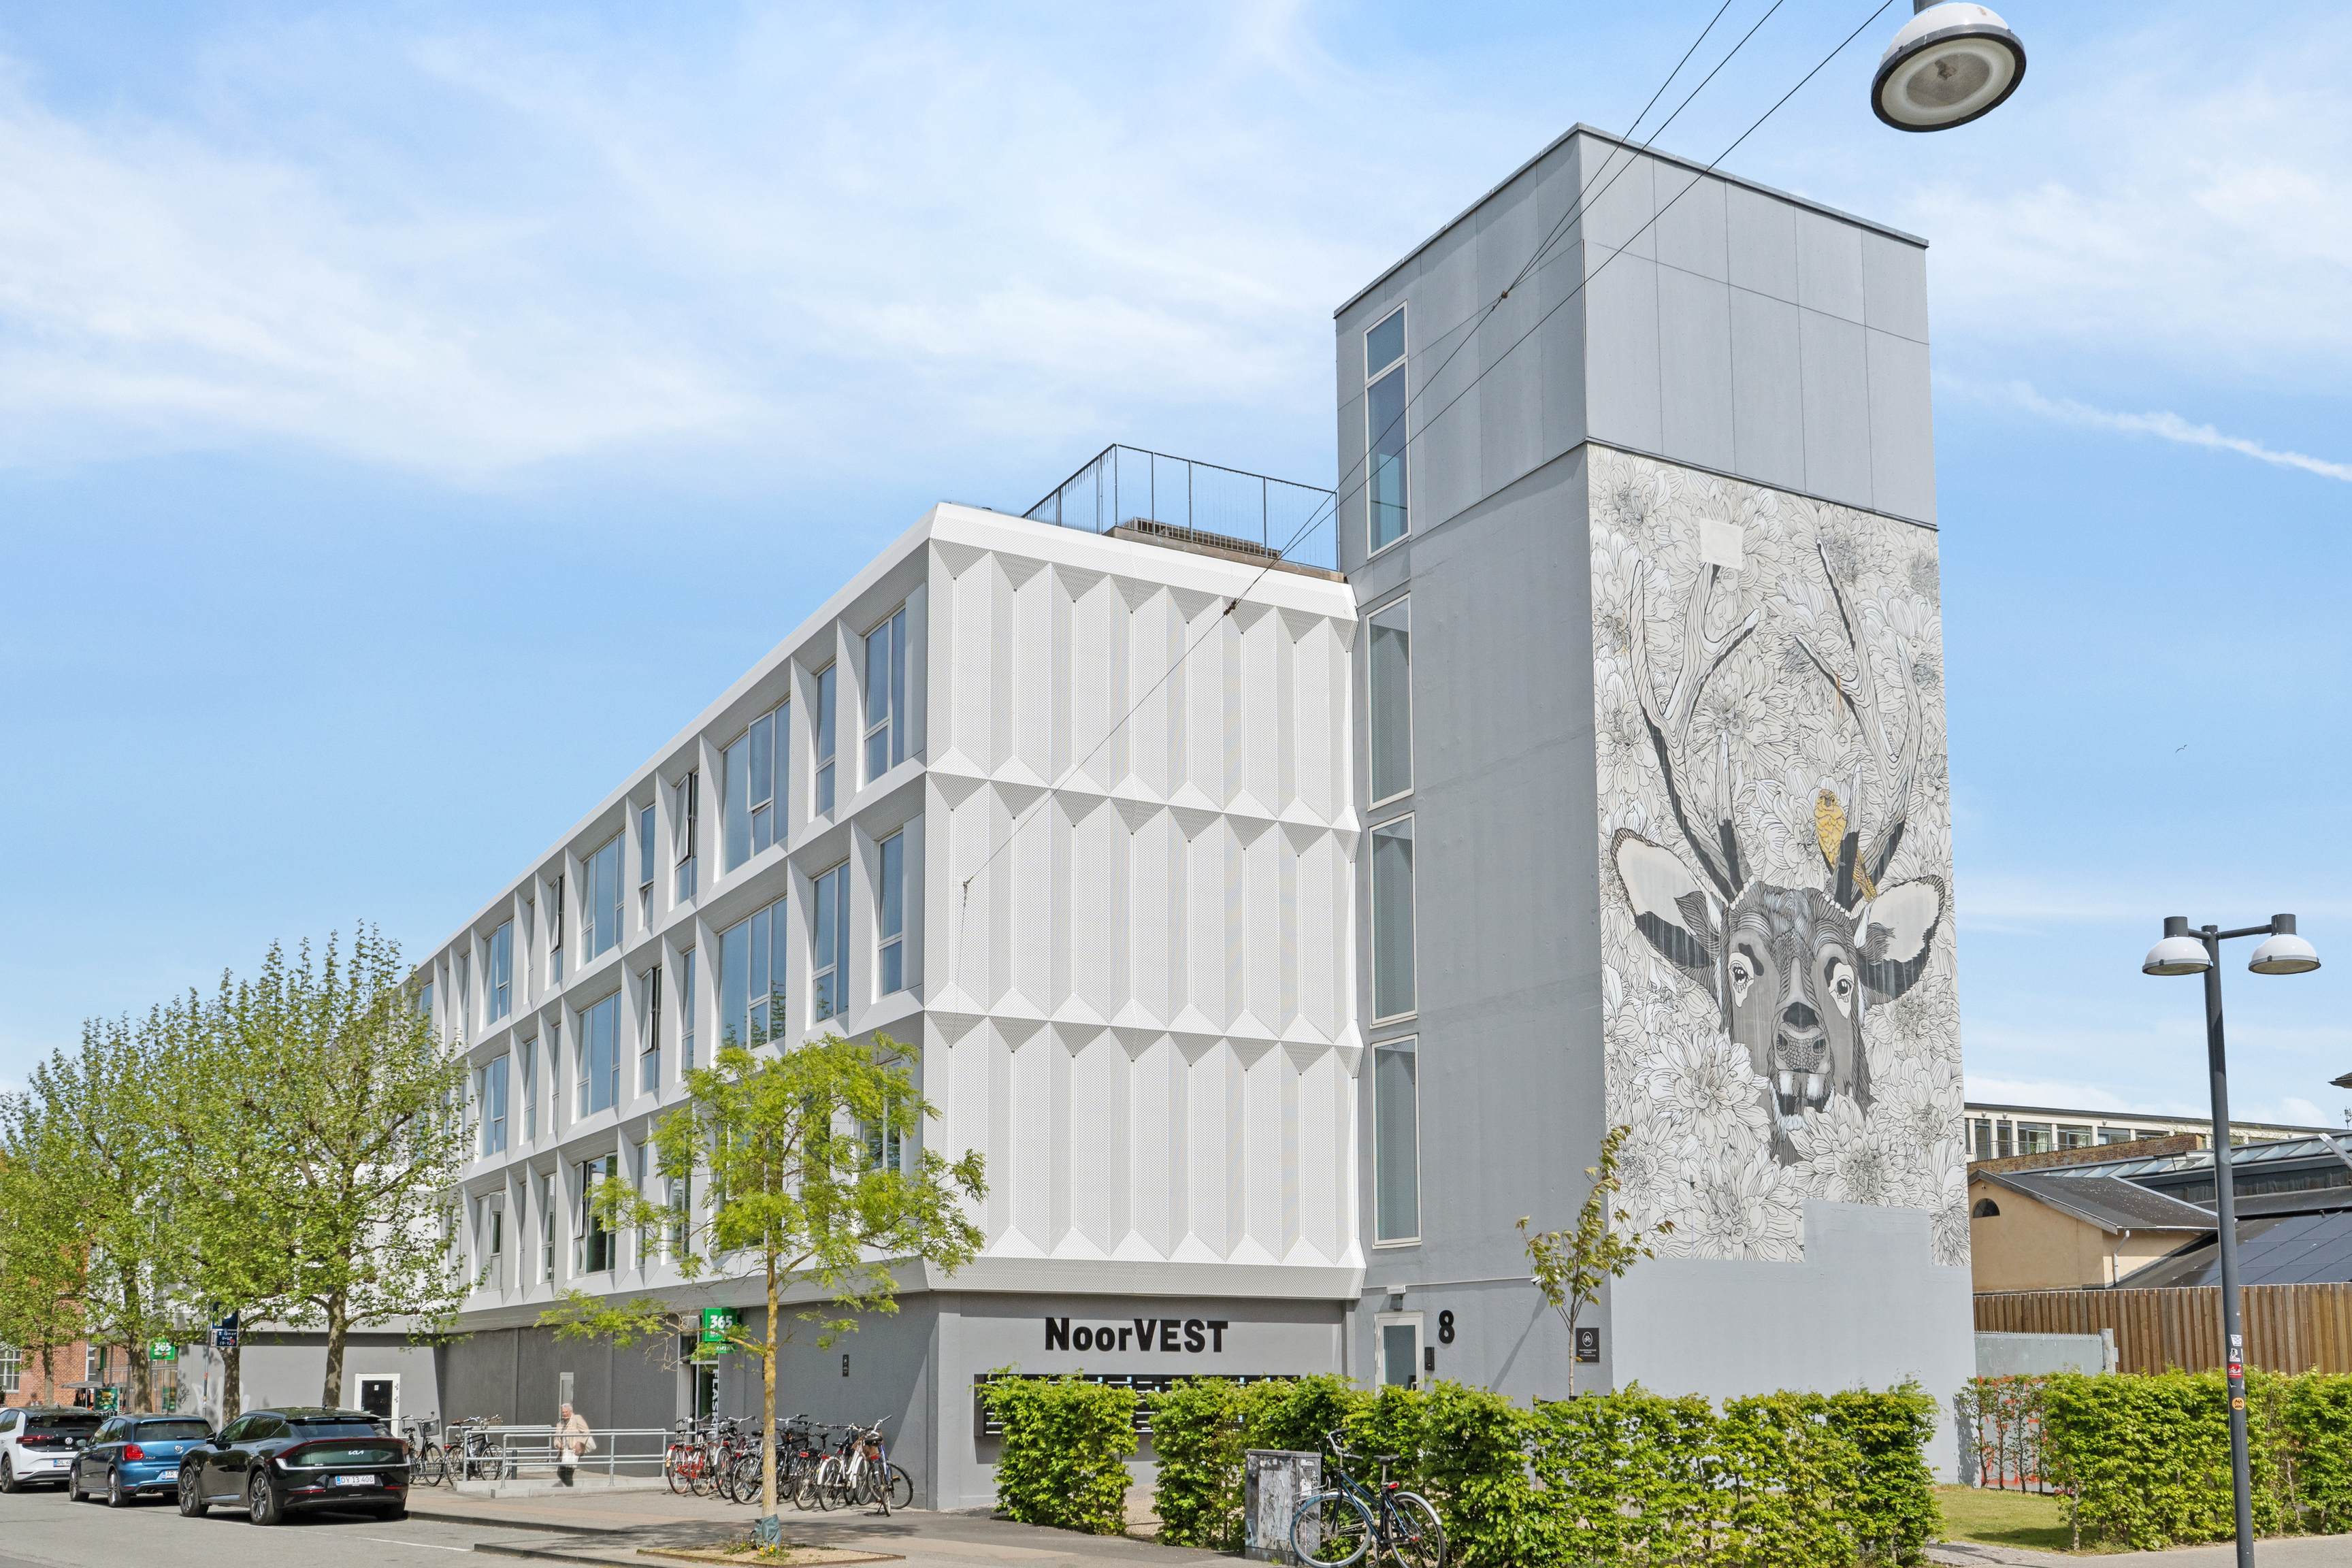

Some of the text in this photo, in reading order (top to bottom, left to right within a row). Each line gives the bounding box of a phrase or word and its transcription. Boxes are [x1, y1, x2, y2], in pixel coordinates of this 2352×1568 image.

[710, 1315, 733, 1329] 365
[1045, 1317, 1228, 1353] NoorVEST
[1438, 1309, 1455, 1344] 8
